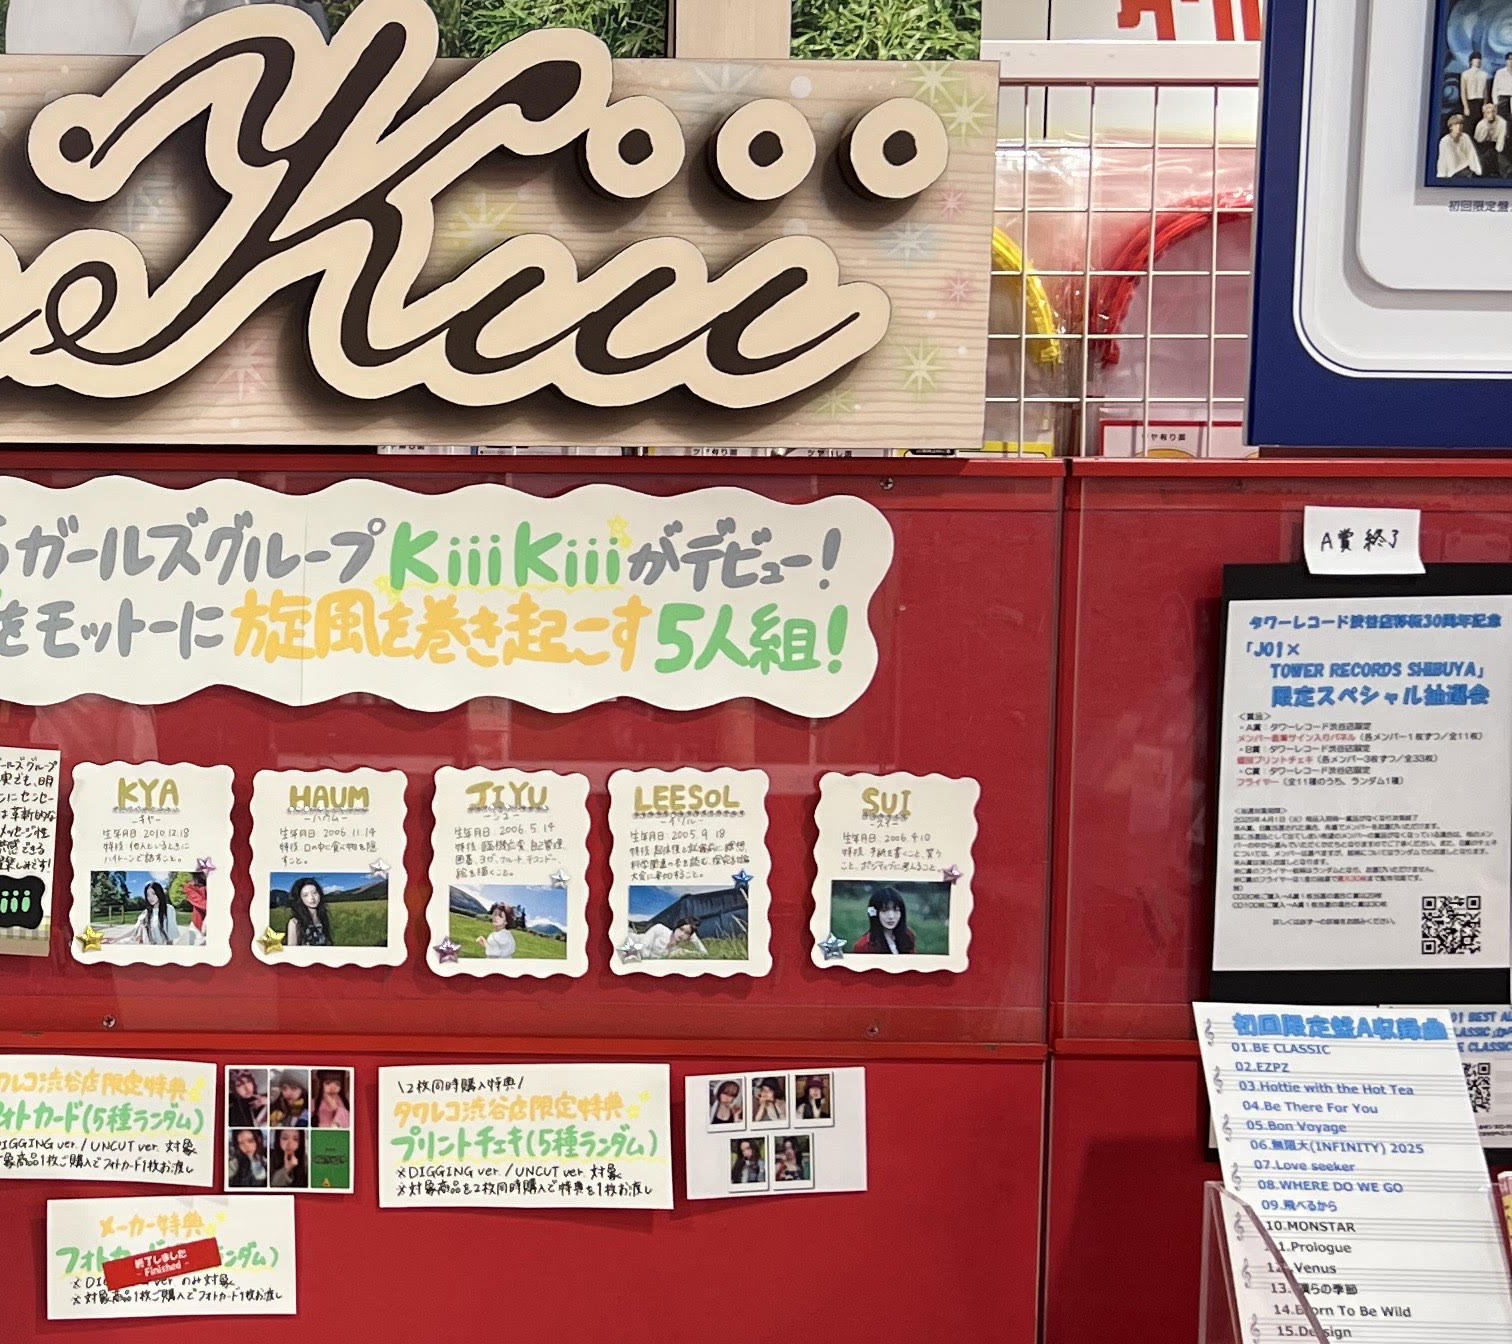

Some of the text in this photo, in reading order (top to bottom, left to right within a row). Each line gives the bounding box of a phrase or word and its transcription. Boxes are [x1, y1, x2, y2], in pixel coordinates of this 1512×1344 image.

[1270, 663, 1325, 679] TOWER
[1329, 663, 1402, 678] RECORDS
[118, 777, 179, 810] KYA
[290, 785, 369, 809] HAUM
[465, 781, 548, 808] JIYU
[861, 787, 912, 817] SUI
[1232, 1042, 1331, 1055] 01.BE CLASSIC
[1235, 1061, 1290, 1073] 02.EZPZ
[1239, 1080, 1414, 1096] 03.Hottie with the Hot Tea
[1243, 1100, 1378, 1114] 04.Be There For You
[1246, 1120, 1347, 1135] 05.Bon Voyage
[90, 1140, 135, 1152] UNCUT
[390, 1124, 657, 1161] プリントチェキ(5種ランダム)
[1391, 1142, 1424, 1154] 2025
[515, 1165, 559, 1178] UNCUT
[1254, 1159, 1355, 1172] 07.Love seeker
[1258, 1179, 1404, 1194] 08.WHERE DO WE GO
[1266, 1220, 1356, 1233] 10.MONSTAR
[1339, 1305, 1356, 1317] To
[1360, 1306, 1377, 1318] Be
[1381, 1306, 1411, 1318] Wild
